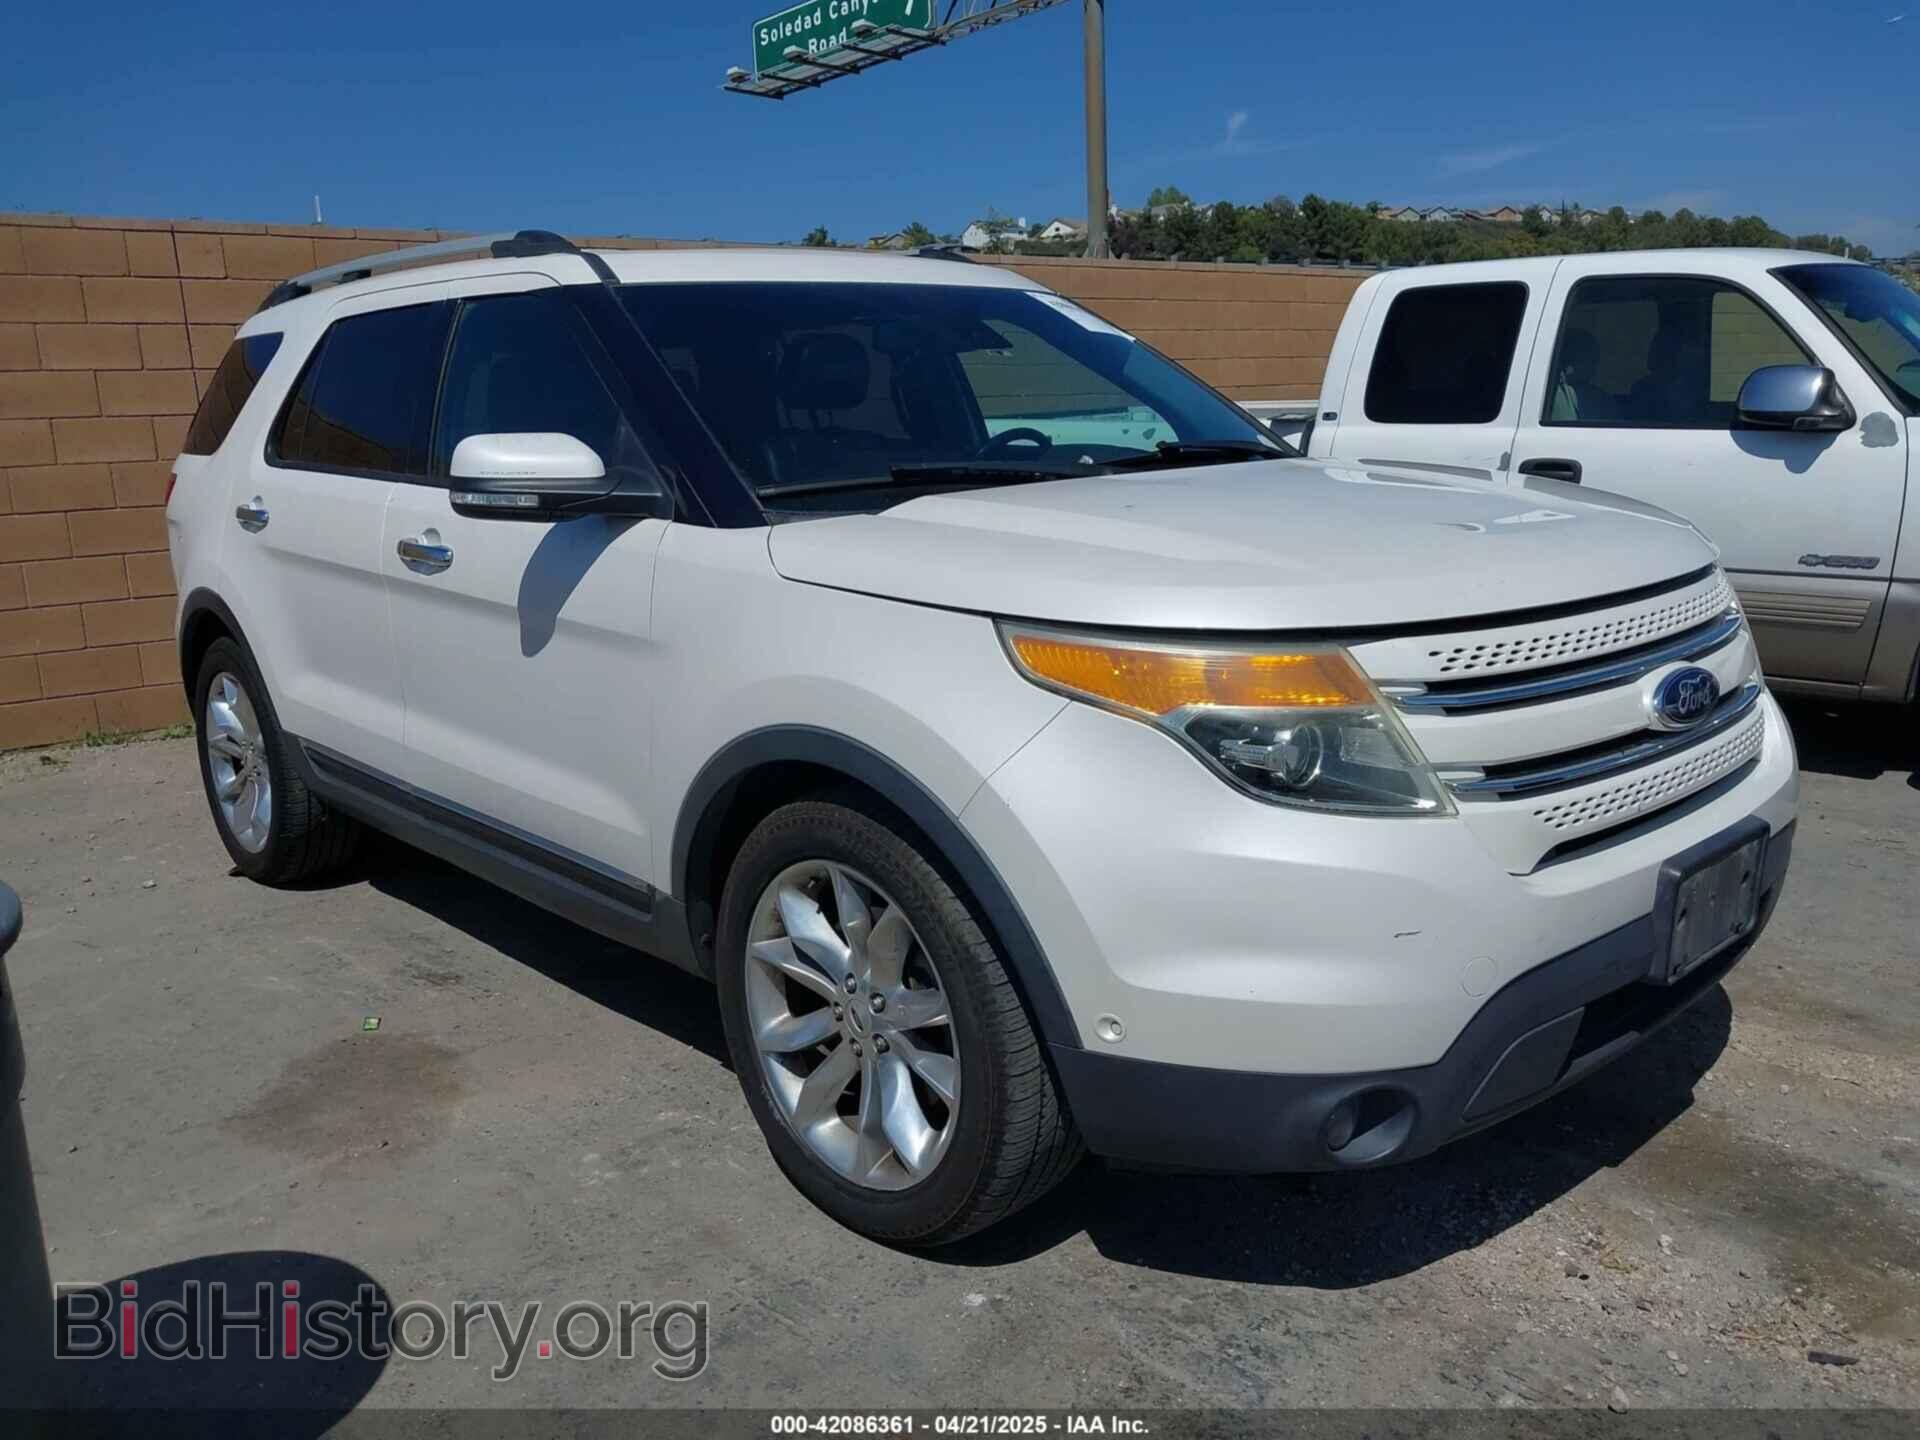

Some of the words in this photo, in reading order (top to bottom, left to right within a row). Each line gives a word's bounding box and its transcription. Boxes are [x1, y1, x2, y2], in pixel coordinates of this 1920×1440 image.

[760, 8, 821, 46] Soledad
[829, 0, 879, 19] Cany
[808, 27, 847, 54] Road
[1678, 675, 1712, 714] Ford
